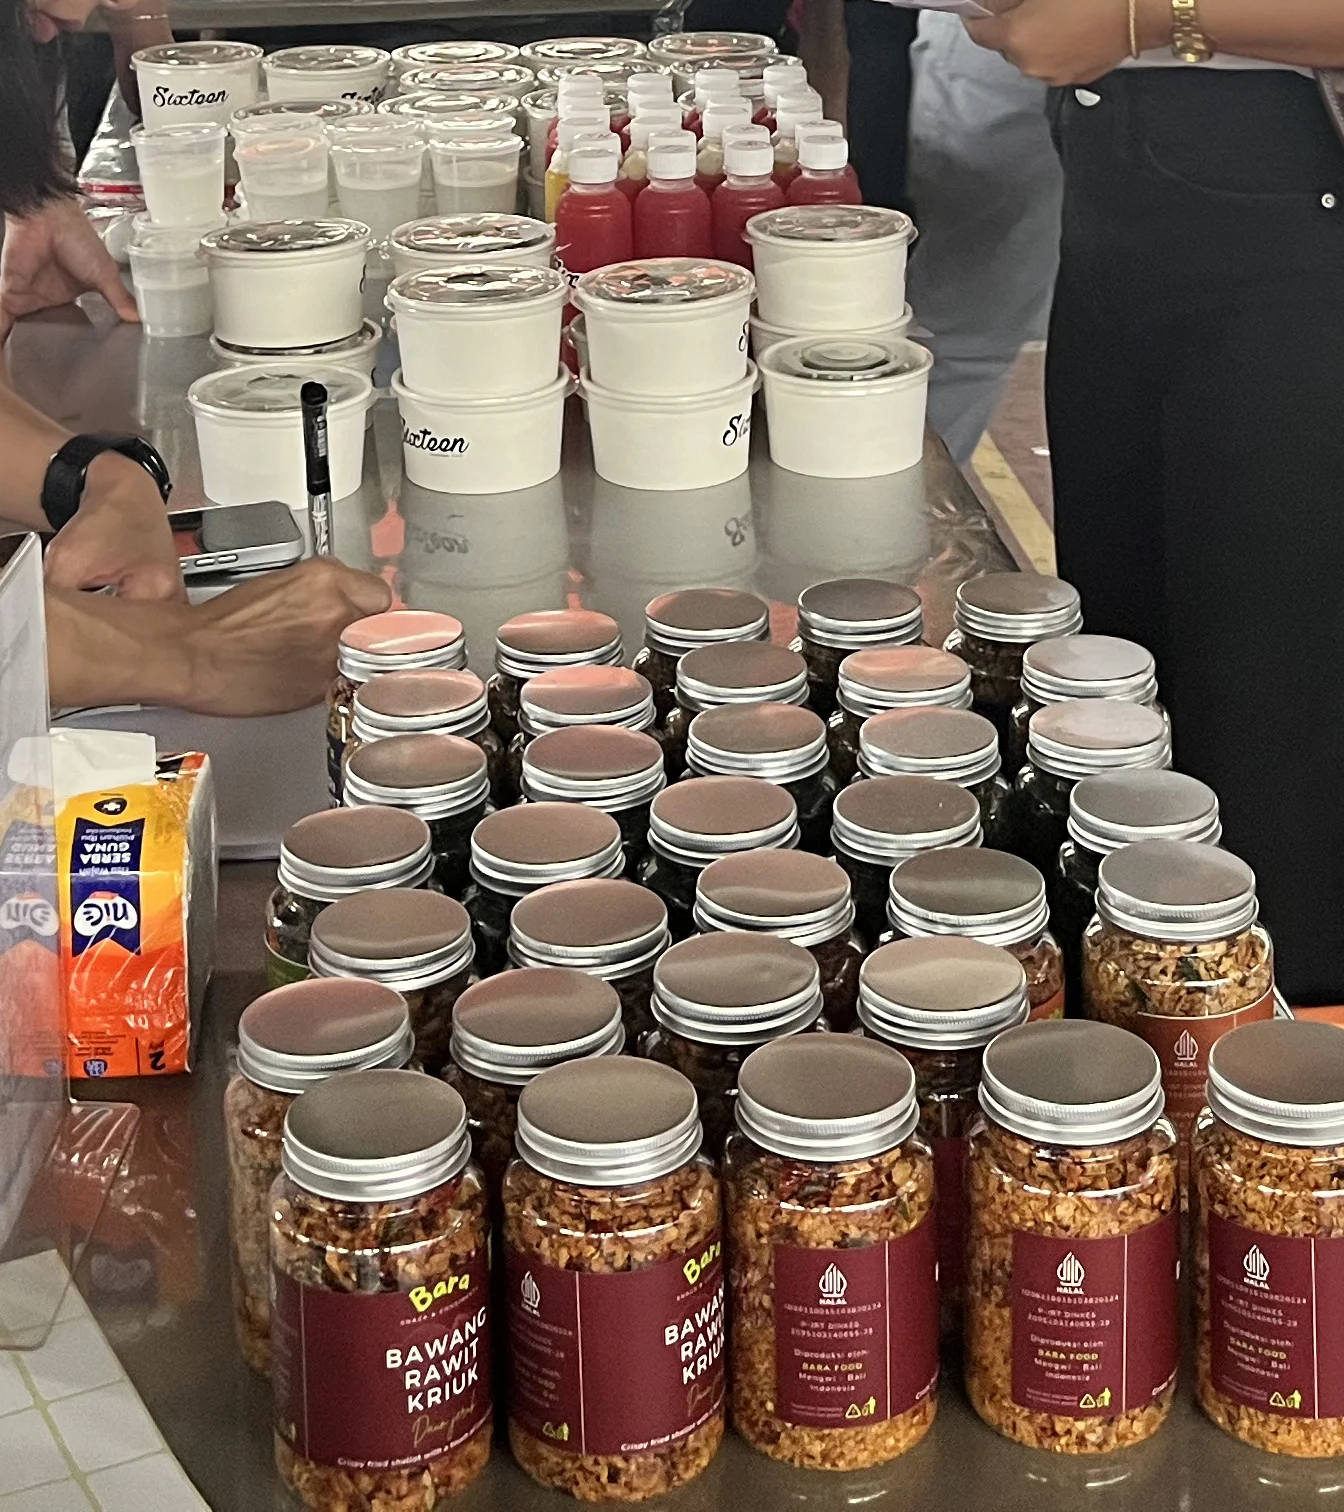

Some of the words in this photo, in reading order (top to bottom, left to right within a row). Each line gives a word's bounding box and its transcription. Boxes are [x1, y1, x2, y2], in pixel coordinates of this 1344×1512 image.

[153, 86, 228, 107] Sixteen
[84, 842, 130, 853] GUNA
[80, 853, 132, 865] SERBA
[149, 1050, 166, 1070] 2
[409, 1274, 470, 1312] Bara
[1056, 1286, 1085, 1295] HALAL
[818, 1297, 848, 1306] HALAL
[385, 1306, 487, 1369] BAWANG
[1038, 1347, 1067, 1360] BARA
[1069, 1351, 1099, 1361] FOOD
[405, 1337, 479, 1390] RAWIT
[802, 1361, 831, 1372] BARA
[407, 1361, 478, 1414] KRIUK
